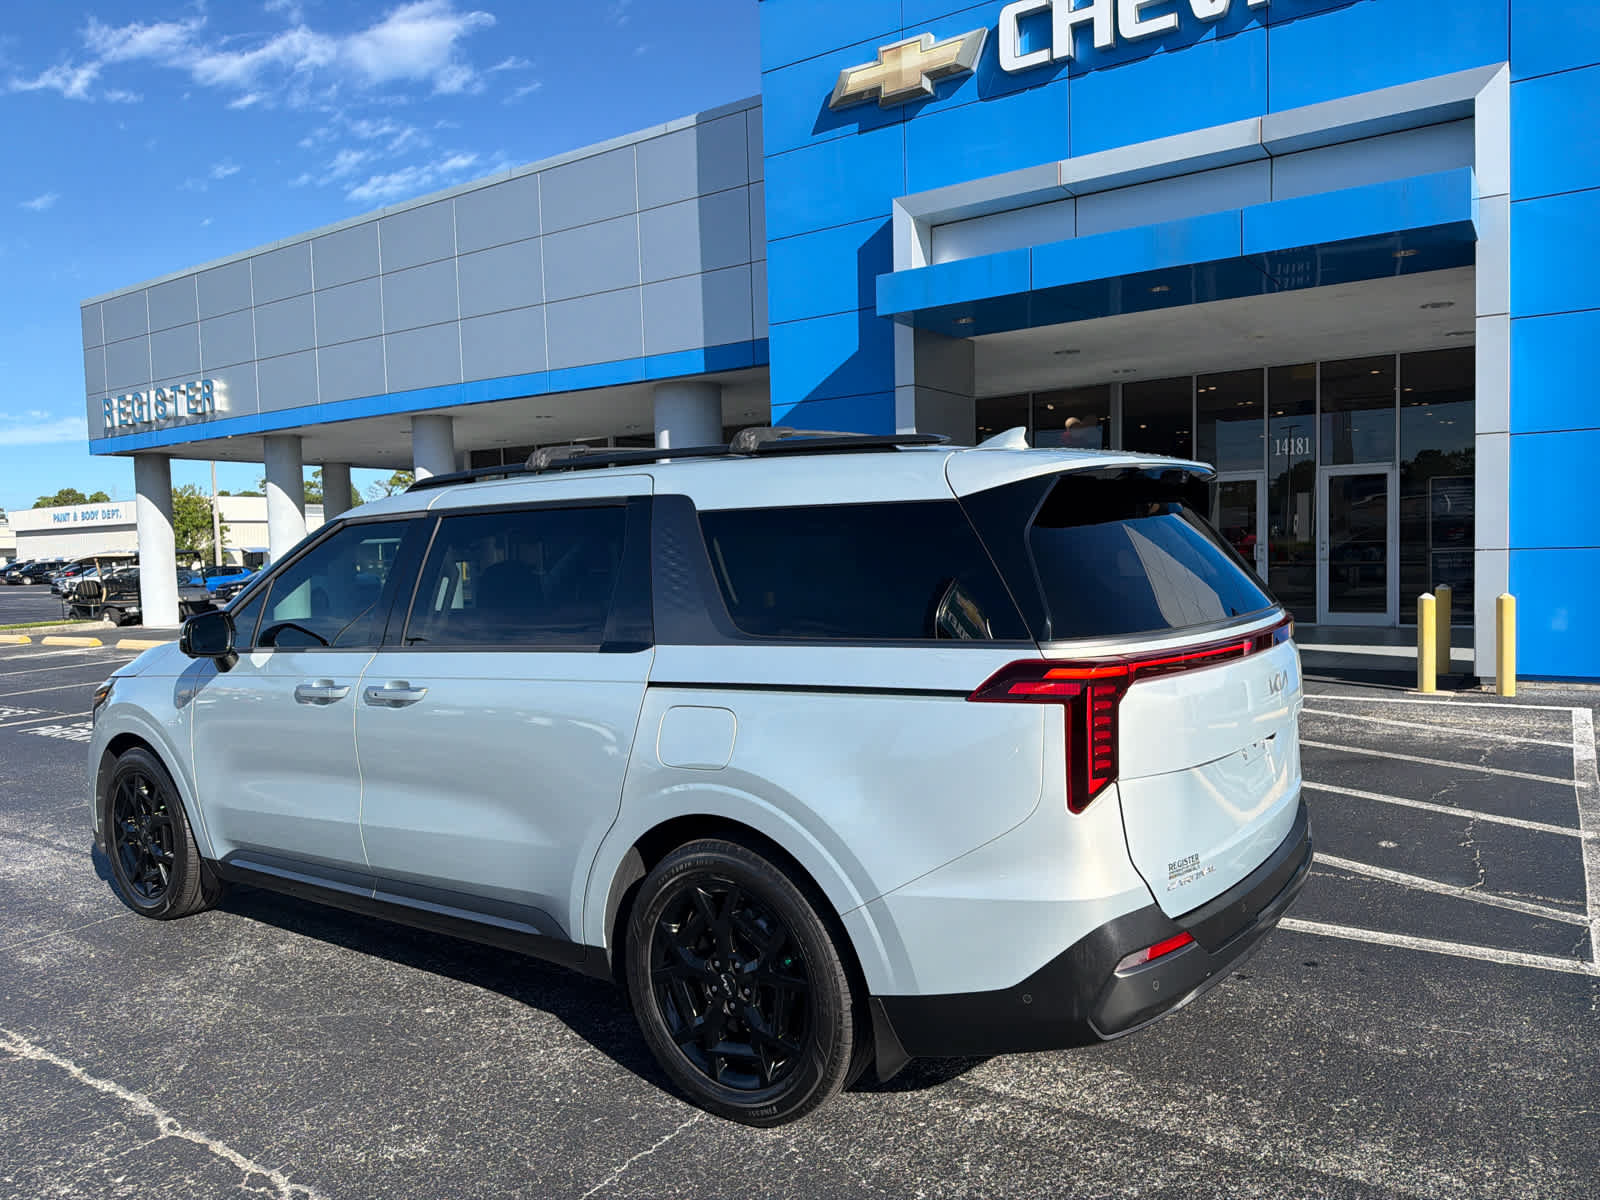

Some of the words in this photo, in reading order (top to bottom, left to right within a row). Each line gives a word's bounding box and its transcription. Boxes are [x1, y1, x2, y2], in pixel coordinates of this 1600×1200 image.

[102, 379, 218, 428] REGISTER
[1275, 436, 1311, 456] 14181
[53, 512, 70, 523] PAINT
[81, 510, 99, 520] BODY
[102, 509, 122, 520] DEPT.
[1168, 853, 1199, 871] REGISTER
